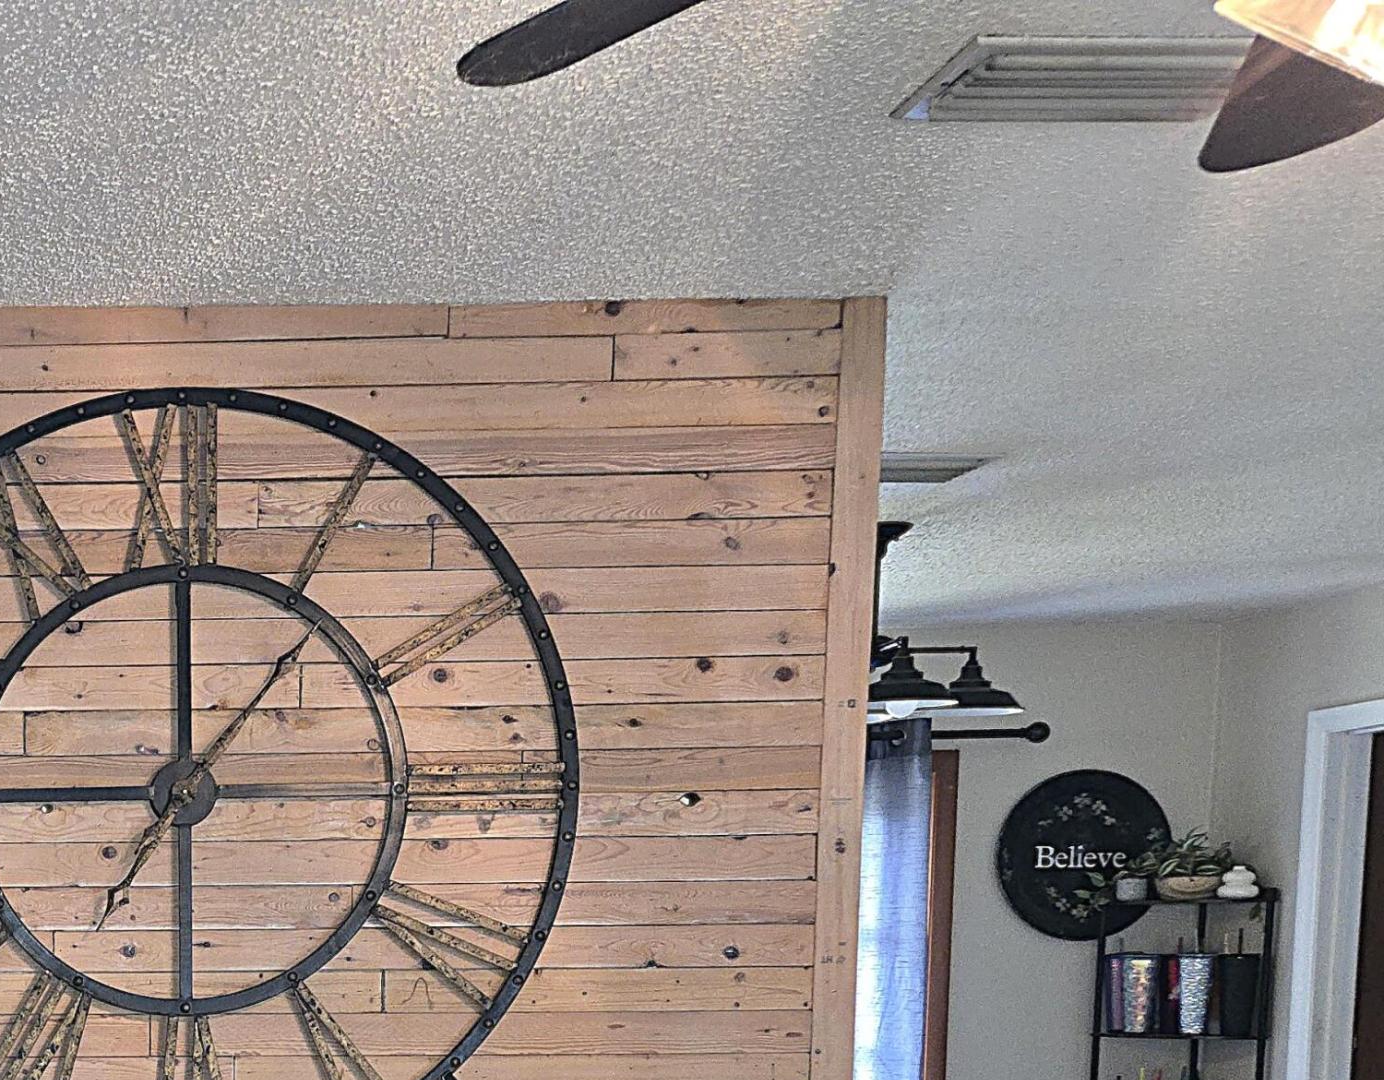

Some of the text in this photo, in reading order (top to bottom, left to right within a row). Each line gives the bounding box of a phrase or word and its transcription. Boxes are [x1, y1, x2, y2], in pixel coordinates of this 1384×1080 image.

[114, 402, 220, 570] XII
[371, 584, 523, 691] II
[407, 761, 566, 814] III
[1034, 845, 1127, 869] Believe
[368, 881, 534, 1010] IV
